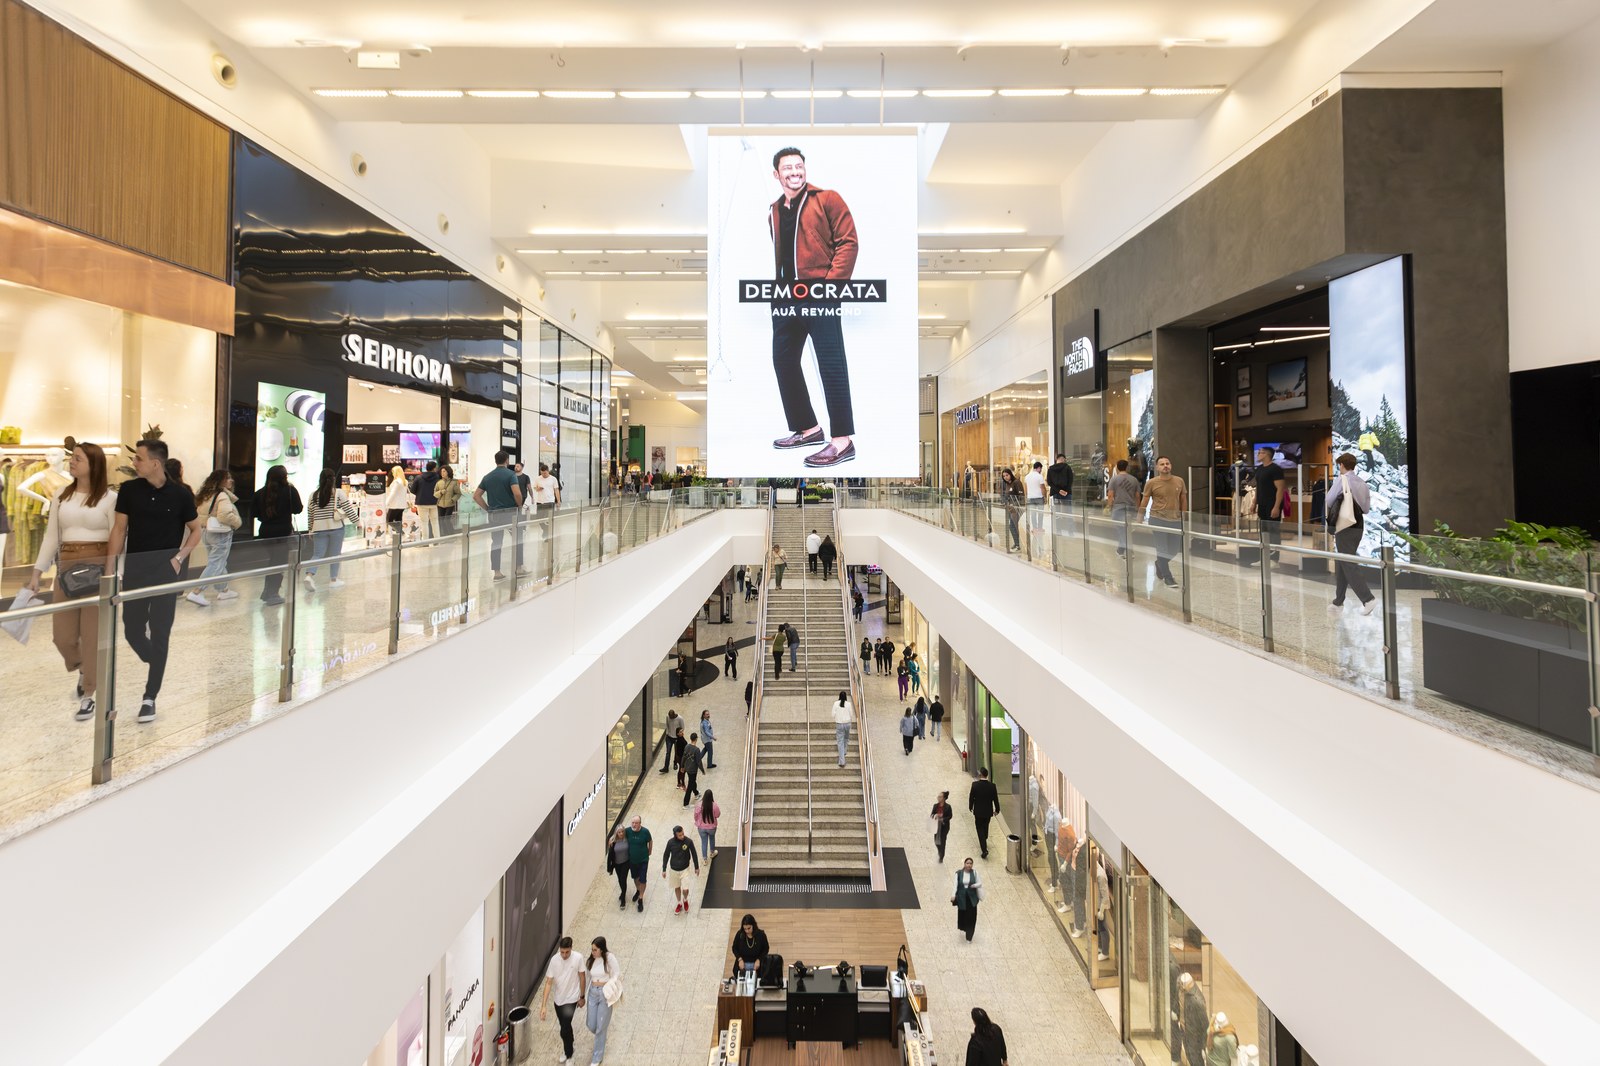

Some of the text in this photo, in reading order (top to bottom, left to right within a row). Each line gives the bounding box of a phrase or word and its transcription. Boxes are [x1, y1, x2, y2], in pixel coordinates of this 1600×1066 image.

[745, 283, 880, 299] DEMOCRATA
[801, 307, 862, 317] REYMOND
[1072, 337, 1083, 352] THE
[342, 333, 454, 387] SEPHORA
[1064, 350, 1083, 366] NORTH
[1067, 360, 1083, 376] FACE
[447, 977, 480, 1032] PANDORA
